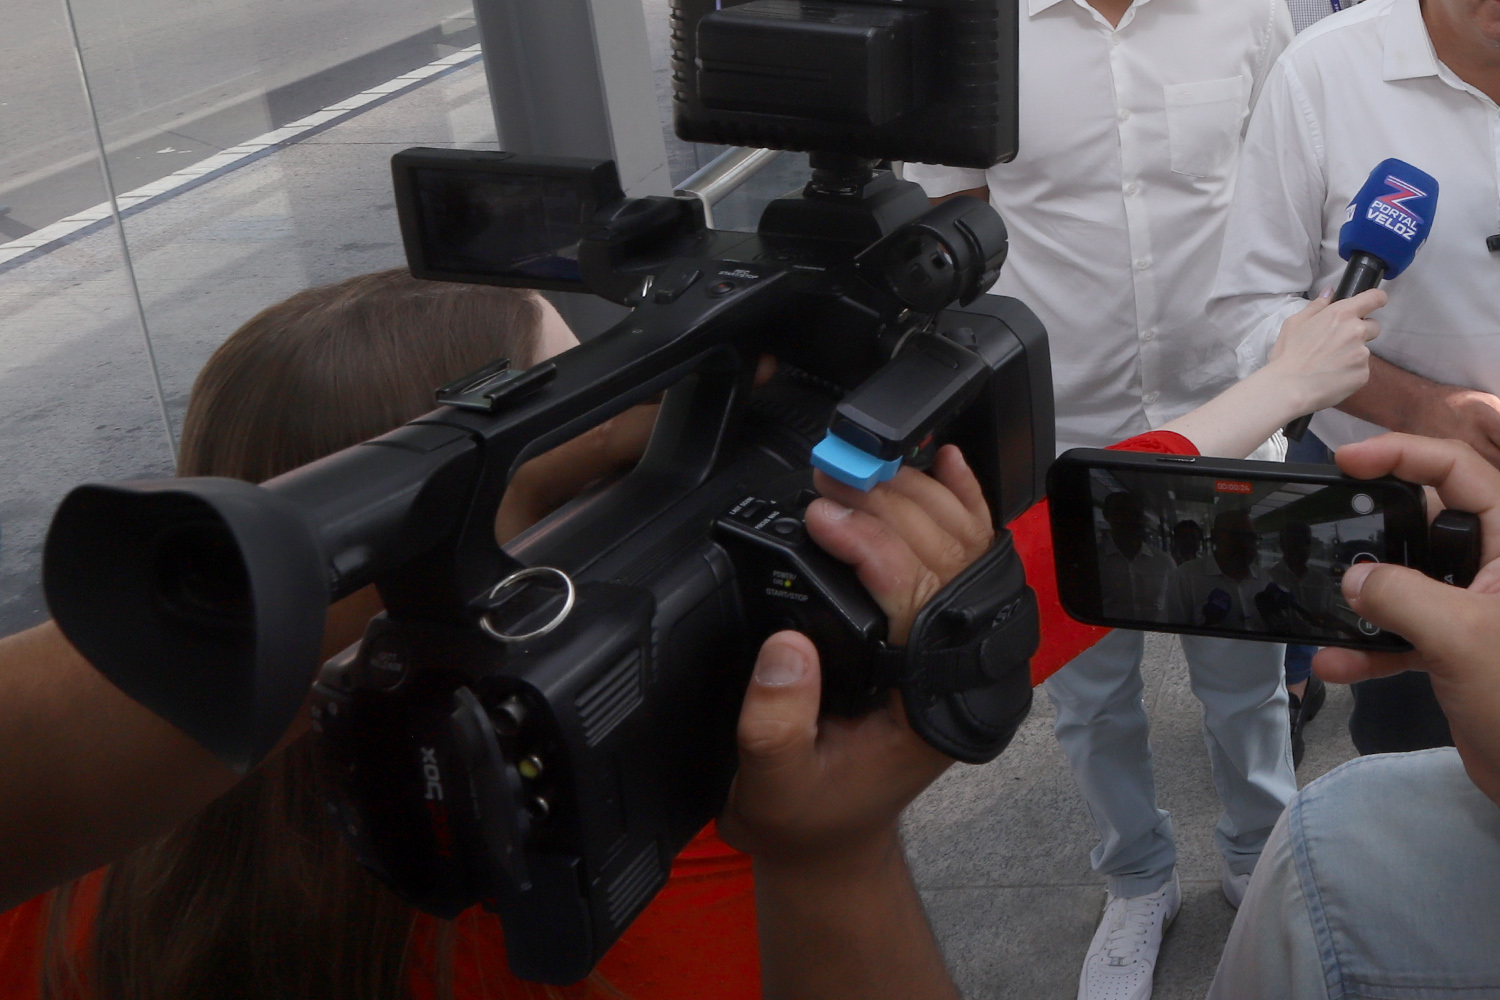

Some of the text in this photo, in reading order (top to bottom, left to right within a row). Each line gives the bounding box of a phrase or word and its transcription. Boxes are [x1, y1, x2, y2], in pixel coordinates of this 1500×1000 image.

[1367, 208, 1416, 240] VELOZ
[1371, 201, 1417, 231] PORTAL
[766, 588, 809, 601] START/STOP
